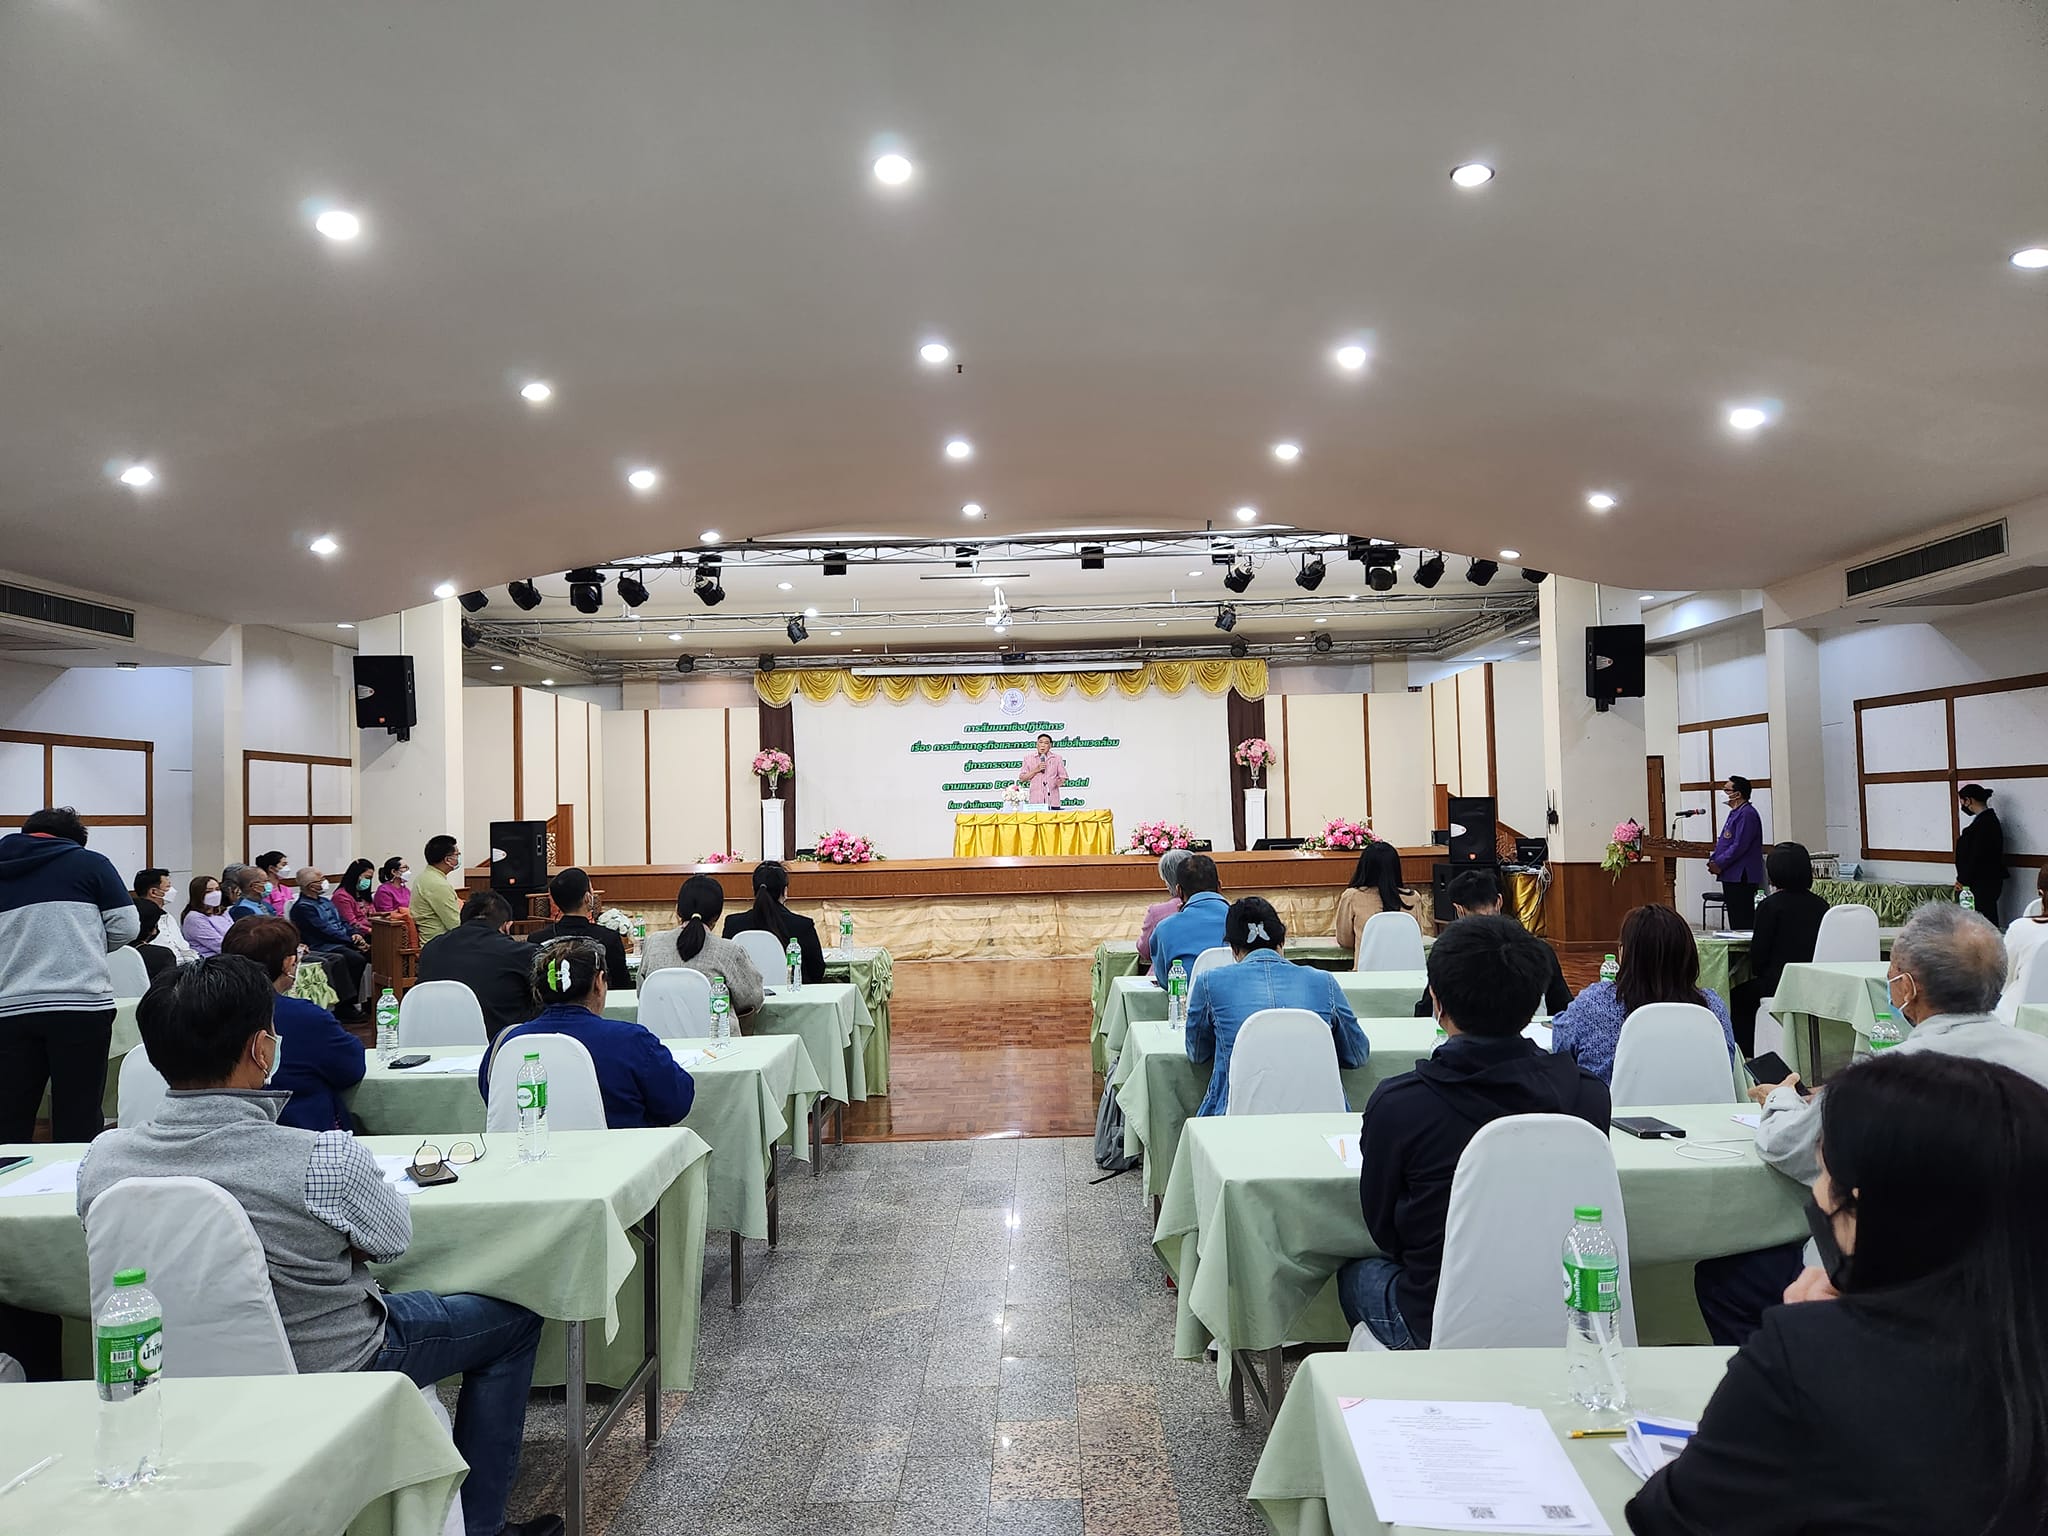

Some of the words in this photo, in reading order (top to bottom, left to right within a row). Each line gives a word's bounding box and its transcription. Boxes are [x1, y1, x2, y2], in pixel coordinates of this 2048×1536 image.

[964, 721, 1065, 733] การสัมมนาเชิงปฏิบัติการ
[911, 740, 932, 752] เรื่อง
[948, 800, 962, 809] โดย
